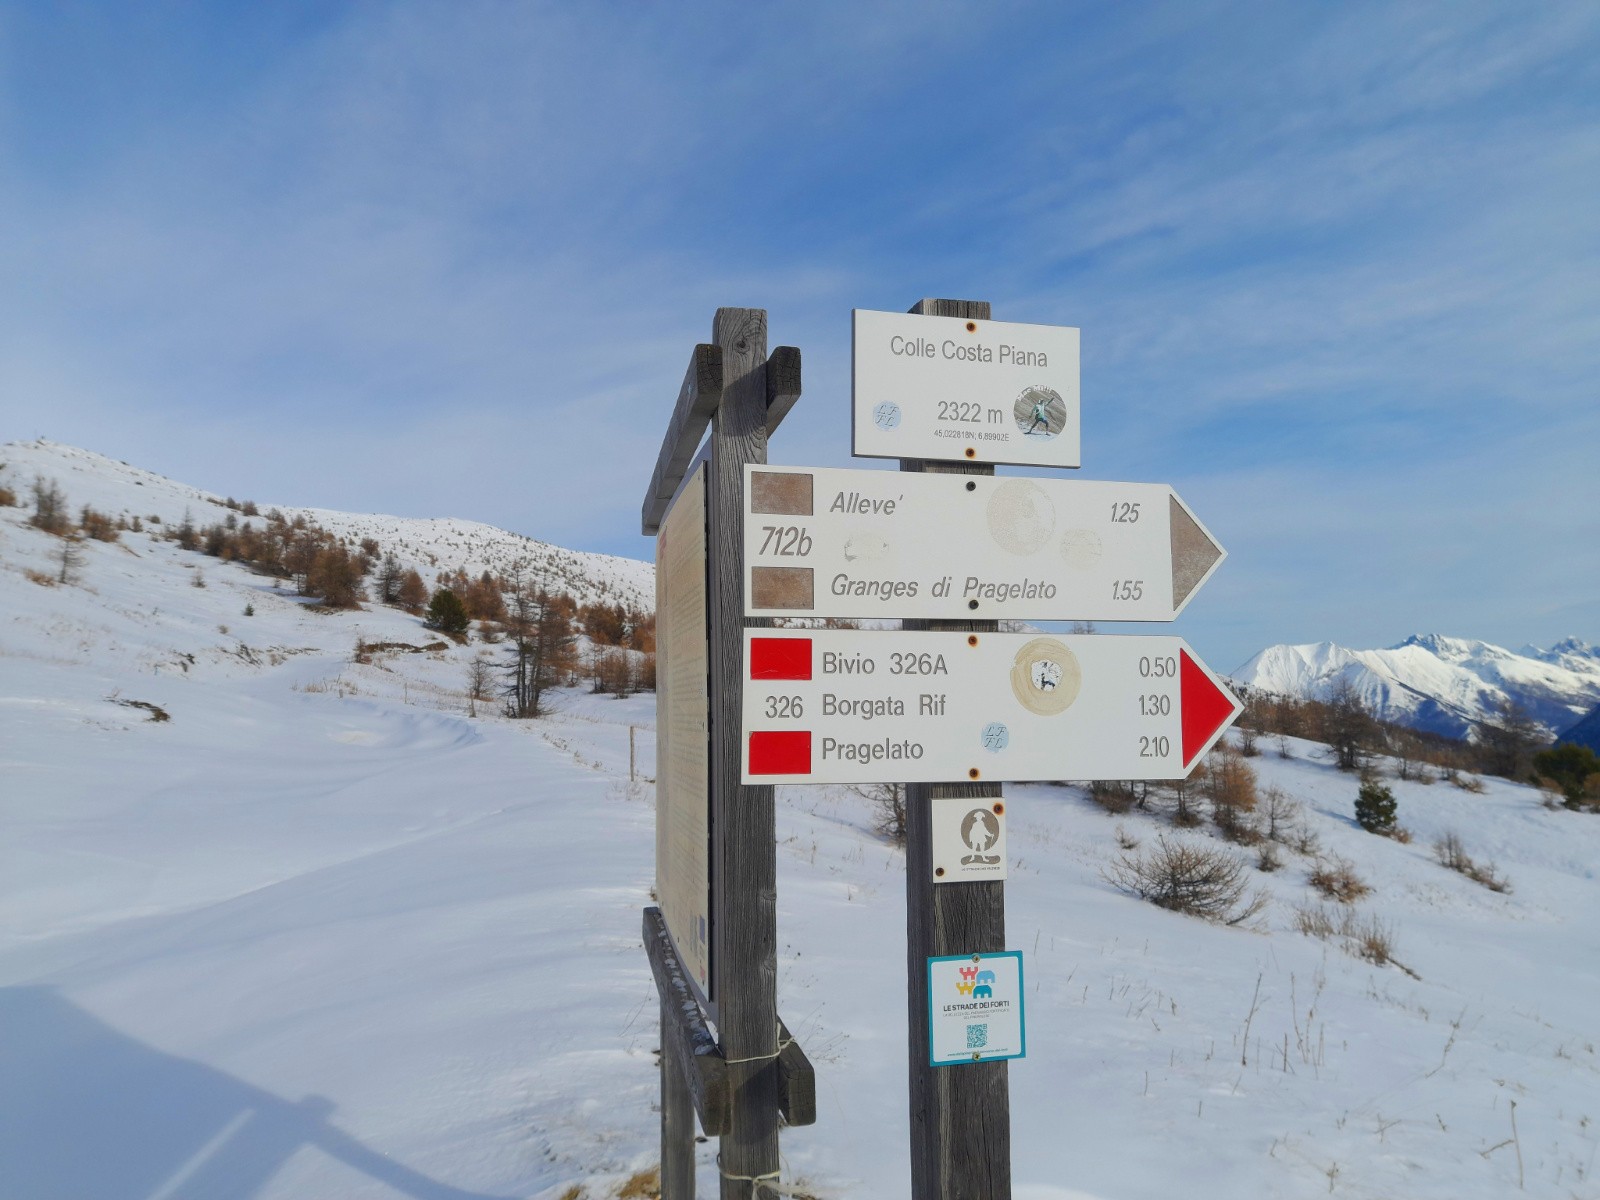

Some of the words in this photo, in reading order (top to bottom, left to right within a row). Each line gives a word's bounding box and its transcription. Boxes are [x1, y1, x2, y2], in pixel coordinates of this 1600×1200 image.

[890, 335, 936, 358] Colle
[942, 340, 993, 363] Costa
[999, 344, 1048, 368] Piana
[938, 400, 982, 423] 2322
[987, 408, 1003, 424] m
[978, 431, 1010, 442] 6,89902E
[829, 491, 904, 516] Alleve'
[1111, 502, 1141, 524] 1.25
[758, 526, 813, 557] 712b
[831, 573, 919, 602] Granges
[931, 576, 953, 598] di
[962, 576, 1057, 603] Pragelato
[1112, 580, 1144, 601] 1.55
[822, 651, 876, 675] Bivio
[889, 652, 949, 676] 326A
[1139, 656, 1176, 678] 0.50
[765, 695, 804, 719] 326
[822, 693, 905, 721] Borgata
[919, 693, 947, 716] Rif
[1138, 694, 1171, 716] 1.30
[822, 737, 924, 765] Pragelato
[1139, 735, 1170, 758] 2.10
[951, 1002, 979, 1012] STRADE
[979, 1001, 990, 1009] DEI
[990, 1000, 1010, 1008] FORTI
